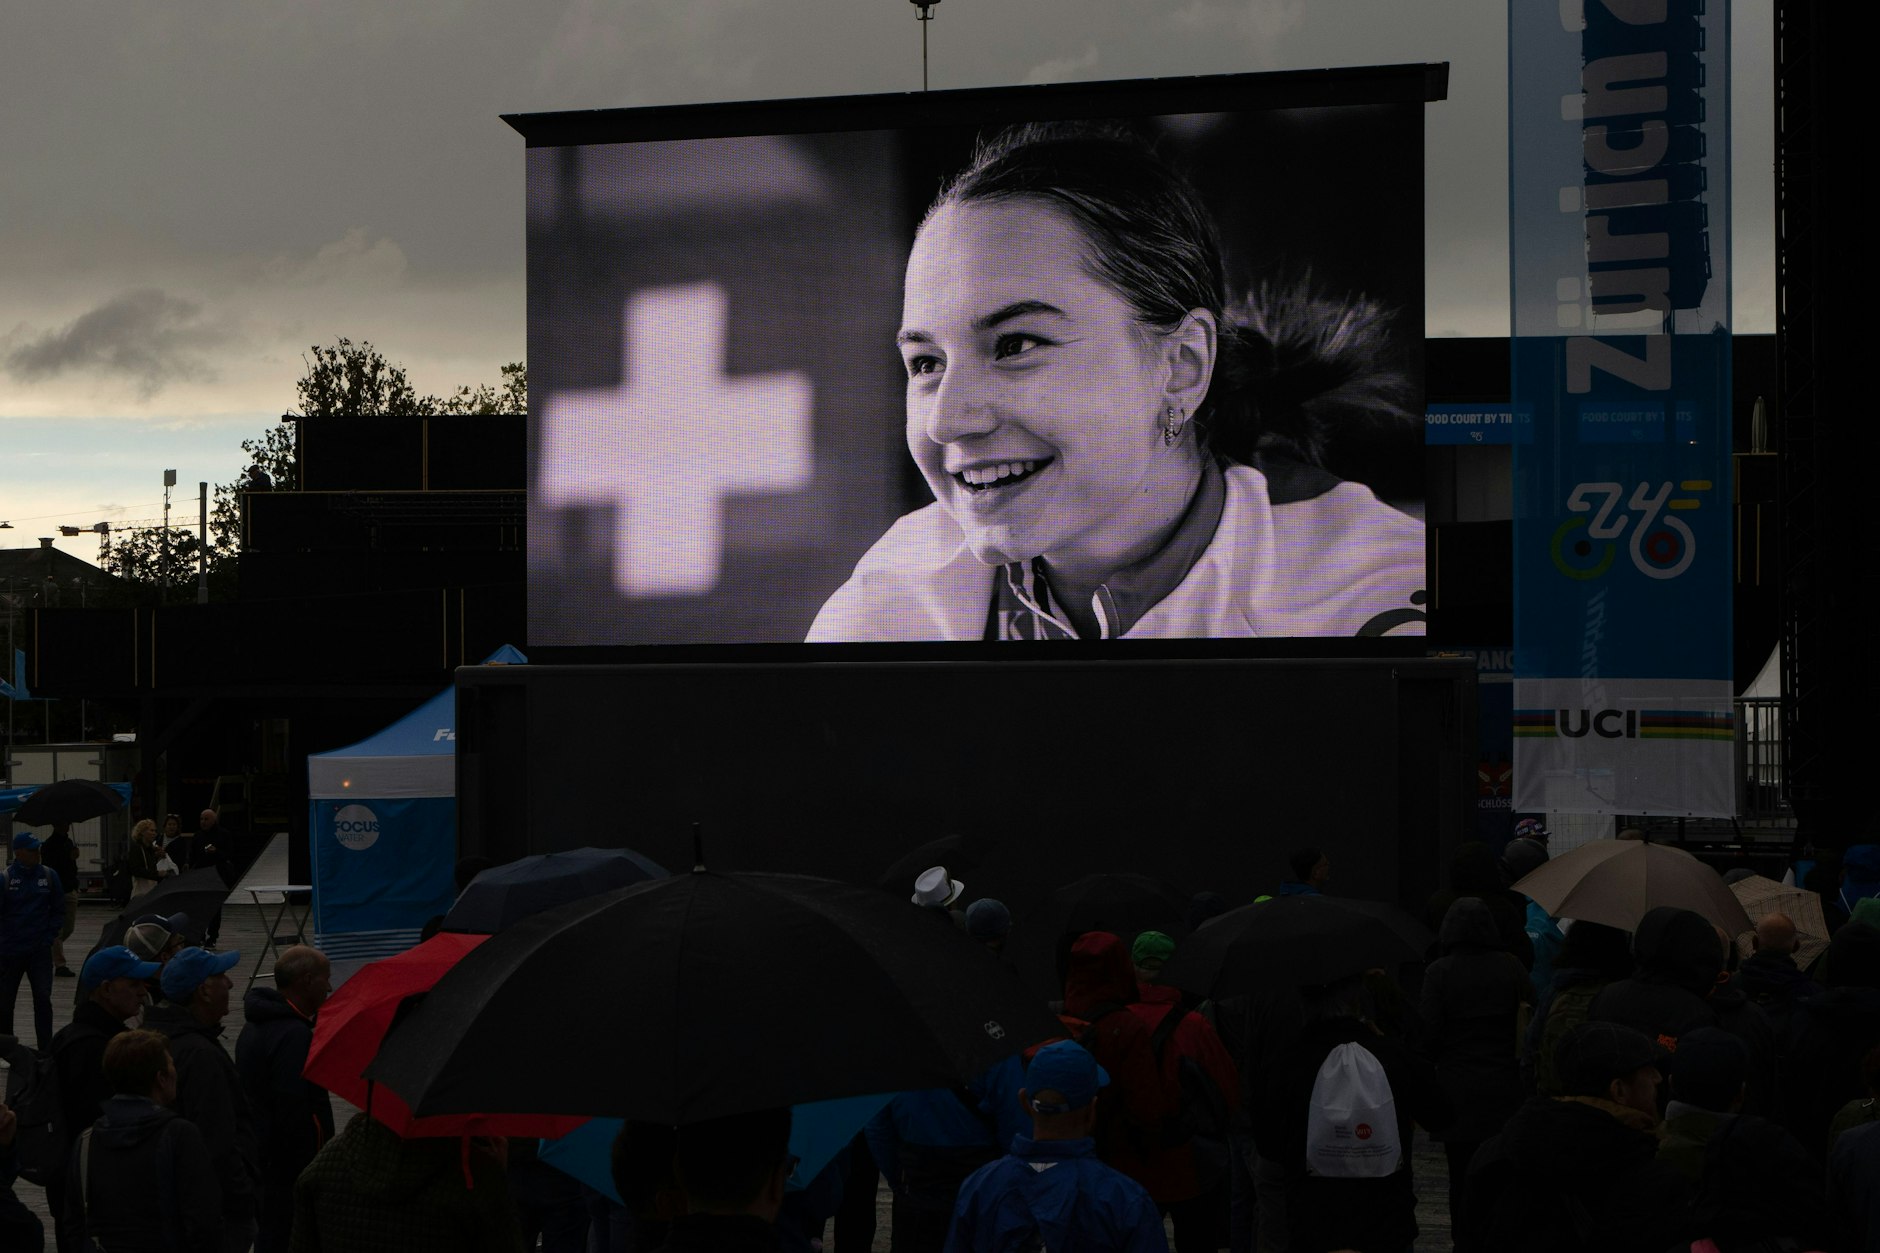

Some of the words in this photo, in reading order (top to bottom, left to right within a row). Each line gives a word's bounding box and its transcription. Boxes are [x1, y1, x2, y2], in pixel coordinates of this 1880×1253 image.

[1557, 50, 1672, 394] Zürich
[1450, 413, 1482, 424] COURT
[1484, 413, 1498, 424] BY
[1582, 412, 1608, 423] FOOD
[1610, 411, 1643, 422] COURT
[1646, 411, 1658, 422] BY
[1560, 709, 1636, 738] UCI
[335, 821, 380, 833] FOCUS
